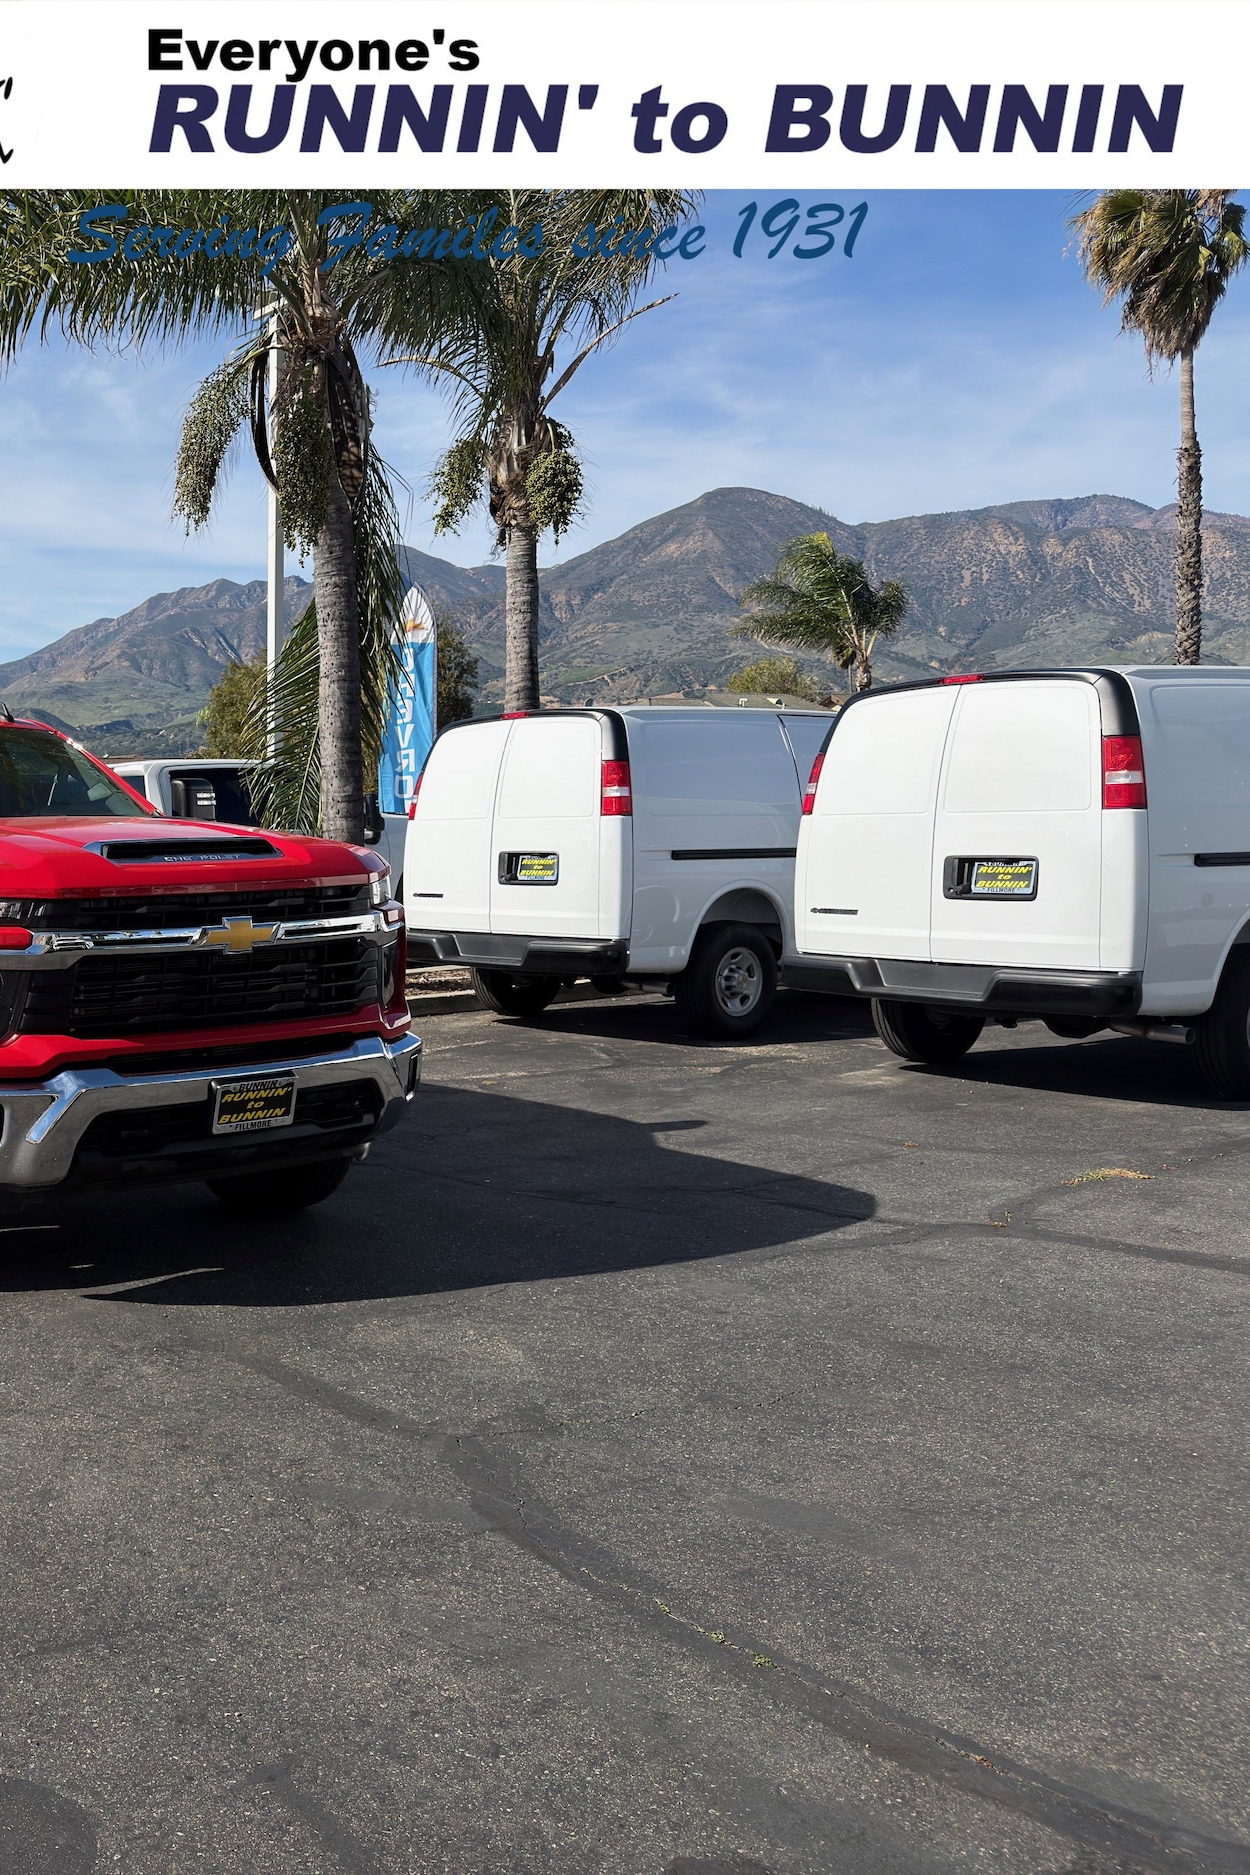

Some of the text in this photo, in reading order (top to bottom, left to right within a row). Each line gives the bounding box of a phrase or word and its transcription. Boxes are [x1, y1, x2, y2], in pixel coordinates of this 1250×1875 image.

[977, 866, 1033, 874] RUNNIN'
[975, 880, 1029, 888] BUNNIN
[239, 1080, 278, 1091] BUNNIN
[221, 1087, 292, 1103] RUNNIN'
[246, 1100, 265, 1110] to
[218, 1108, 285, 1124] BUNNIN
[235, 1120, 271, 1130] FILLMORE
